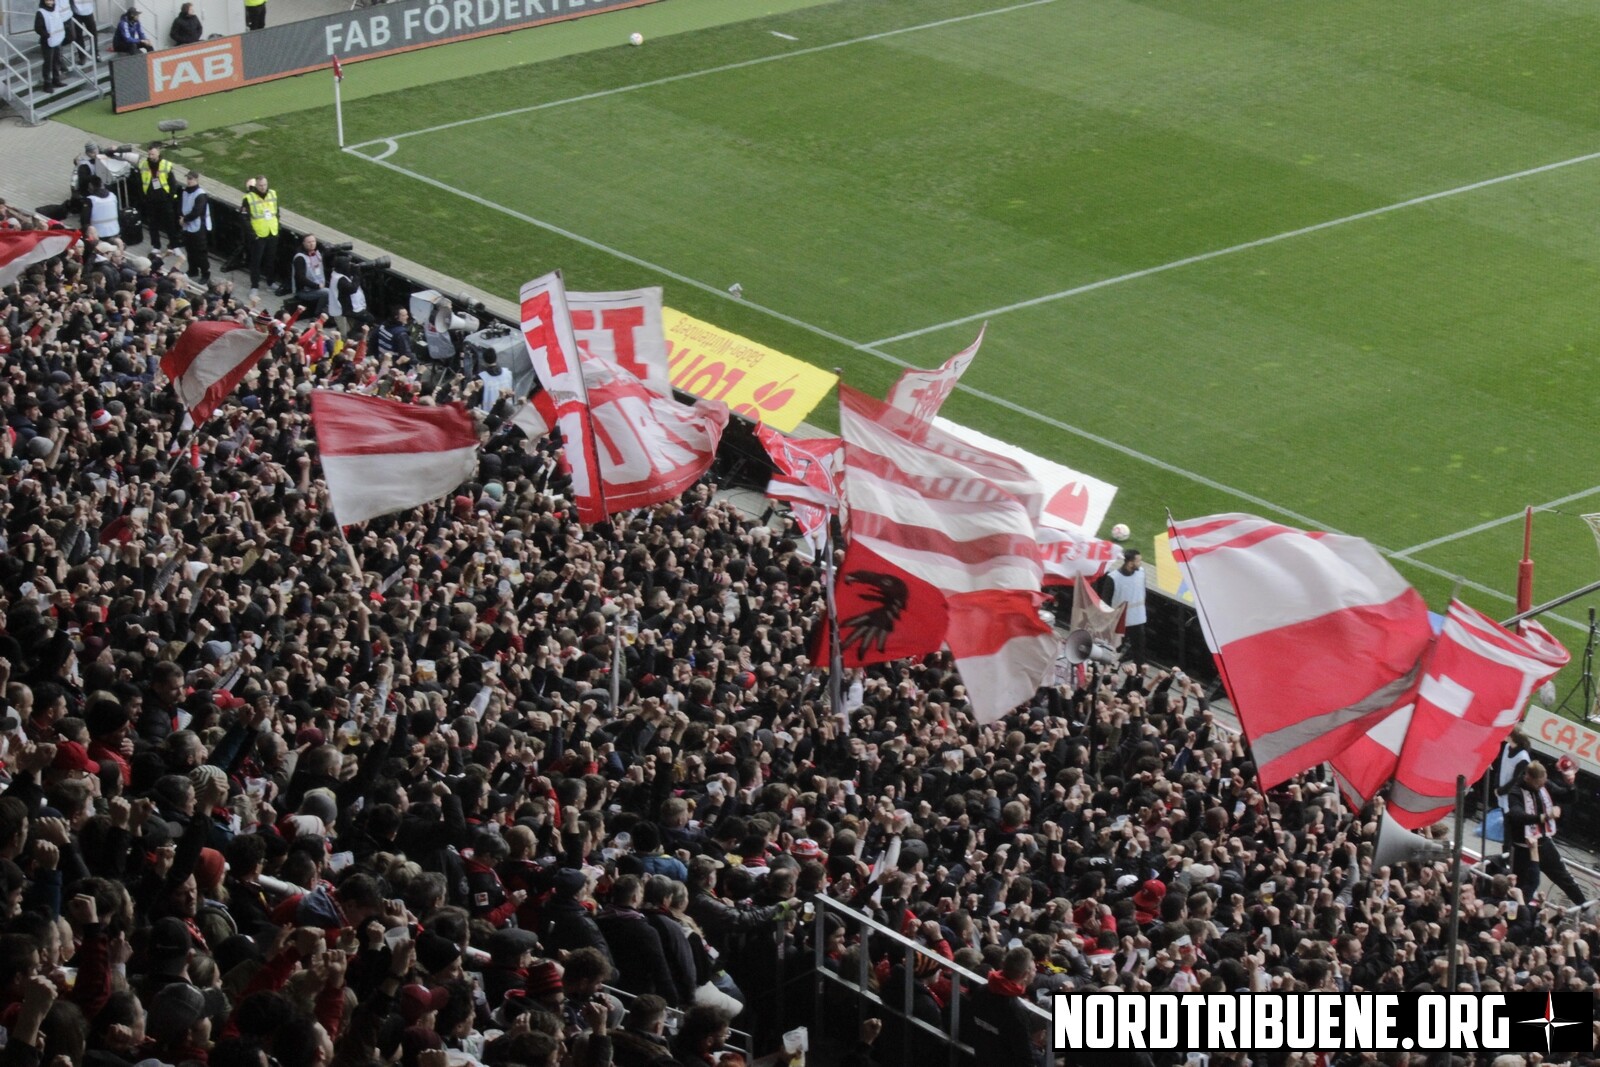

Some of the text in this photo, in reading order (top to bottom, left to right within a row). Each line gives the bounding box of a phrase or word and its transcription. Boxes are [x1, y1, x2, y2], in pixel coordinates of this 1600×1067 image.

[325, 15, 391, 56] FAB
[152, 43, 234, 93] FAB
[669, 317, 766, 368] Baden-Württemberg
[1541, 718, 1600, 763] CAZ
